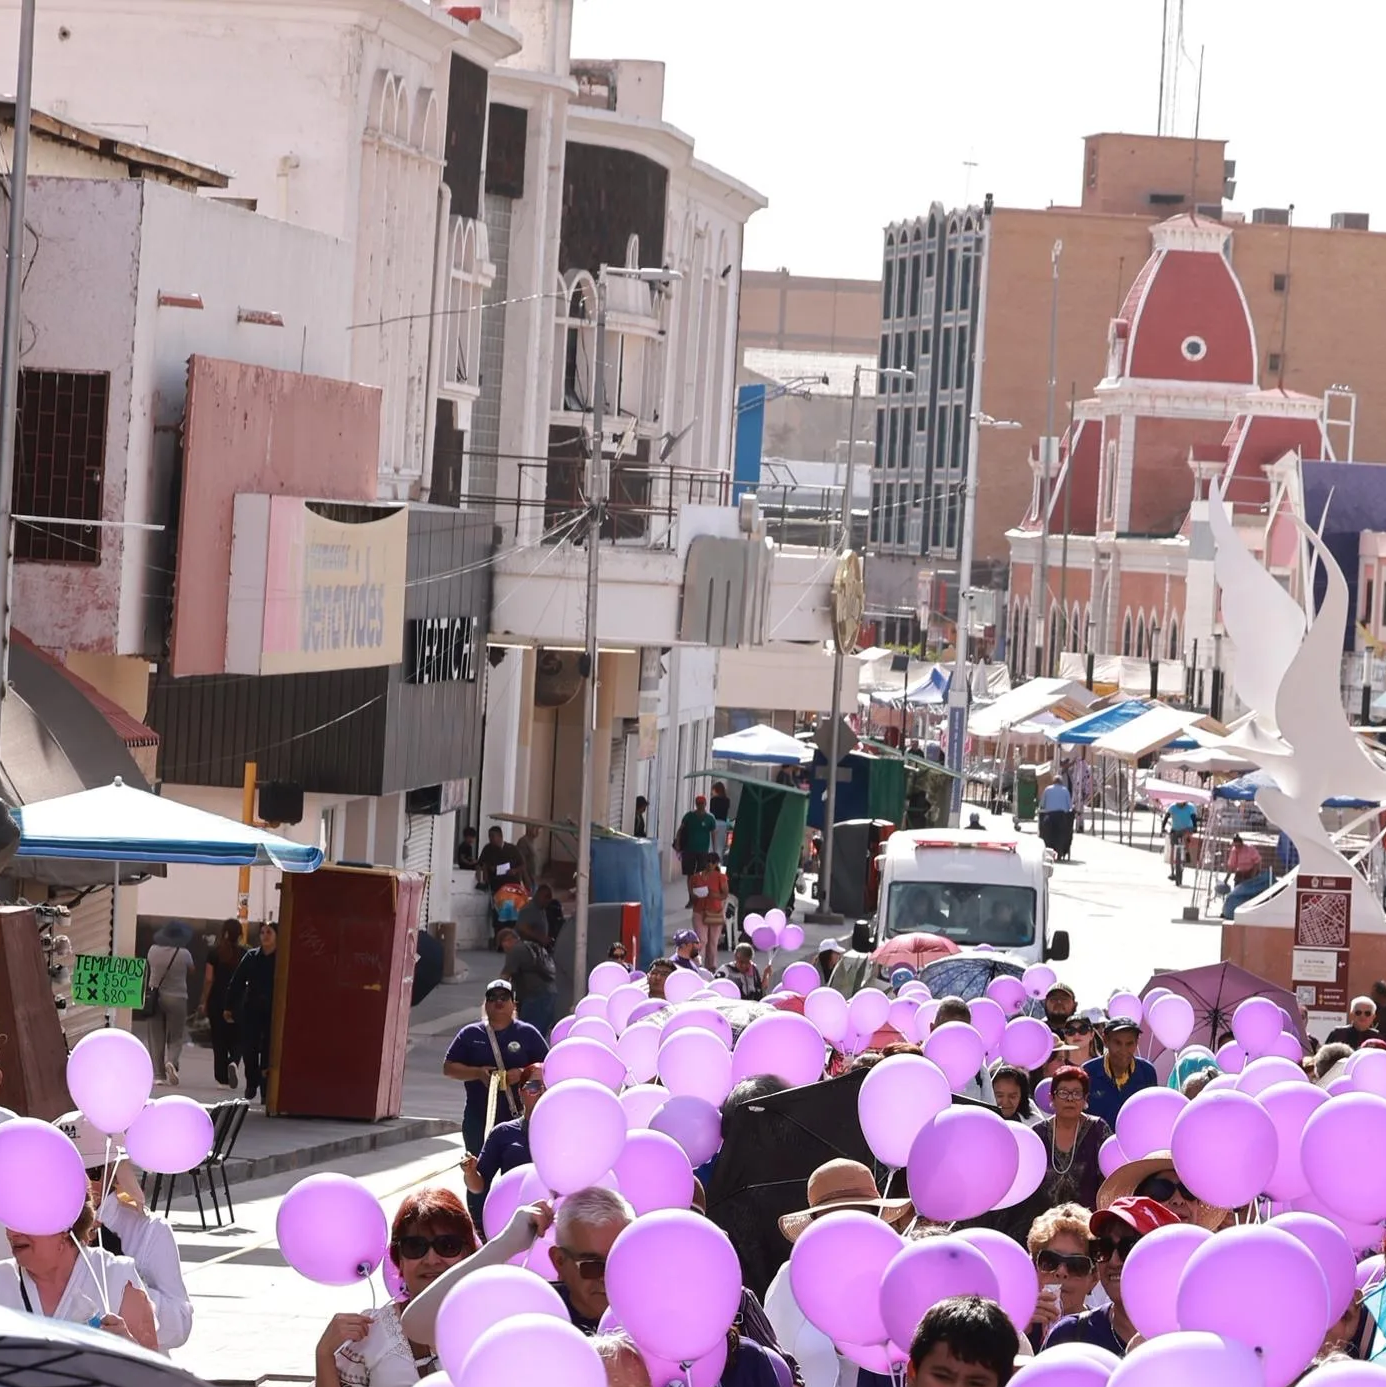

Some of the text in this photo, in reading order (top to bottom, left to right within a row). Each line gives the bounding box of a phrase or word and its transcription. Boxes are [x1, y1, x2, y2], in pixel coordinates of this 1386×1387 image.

[416, 616, 478, 685] VERTICHE
[75, 954, 145, 978] TEMPLADOS
[75, 973, 84, 985] 1
[75, 986, 84, 1001] 2
